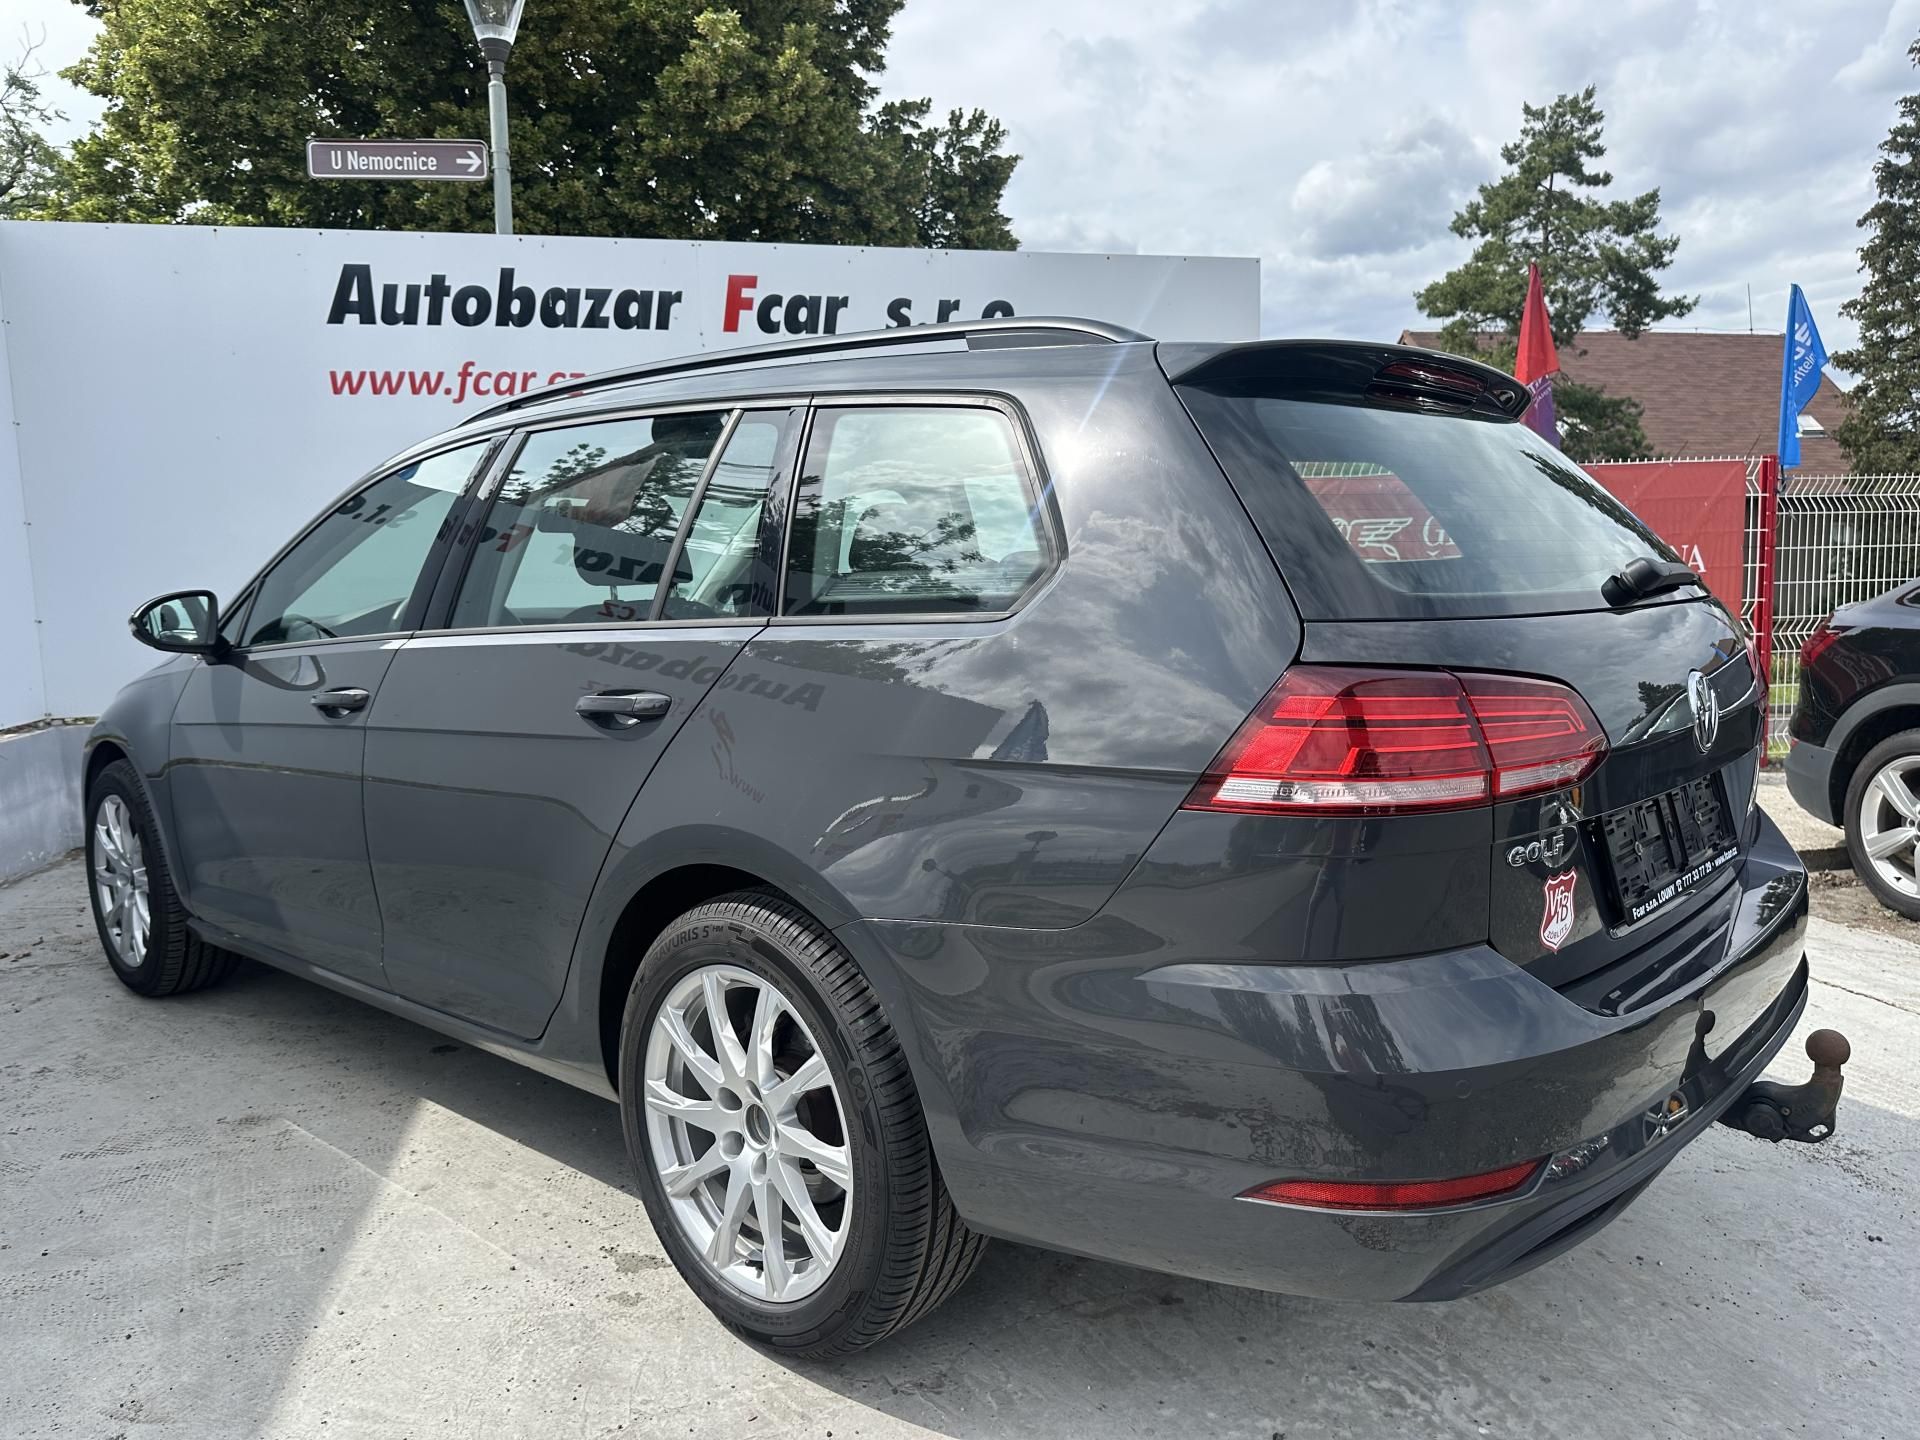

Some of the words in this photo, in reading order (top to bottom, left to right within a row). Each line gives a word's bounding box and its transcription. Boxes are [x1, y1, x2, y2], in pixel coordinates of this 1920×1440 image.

[331, 150, 342, 170] U
[347, 150, 438, 171] Nemocnice
[326, 263, 683, 330] Autobazar
[722, 274, 849, 335] Fcar
[1507, 833, 1565, 867] GOLF
[1549, 885, 1571, 924] VfB
[1632, 905, 1646, 920] Fcar
[1657, 883, 1676, 904] LOUNY
[1682, 873, 1692, 887] 777
[1692, 868, 1700, 881] 33
